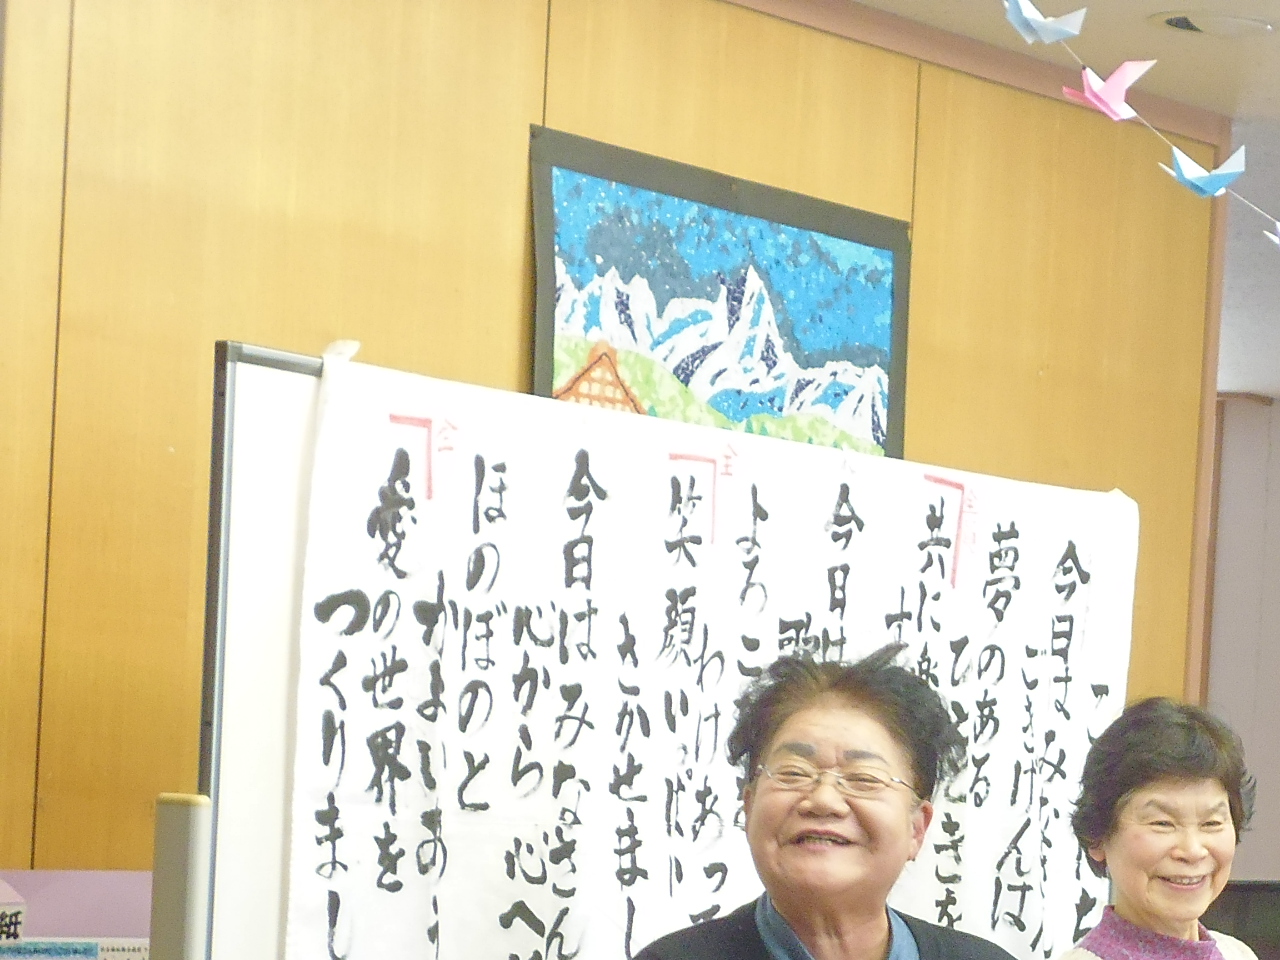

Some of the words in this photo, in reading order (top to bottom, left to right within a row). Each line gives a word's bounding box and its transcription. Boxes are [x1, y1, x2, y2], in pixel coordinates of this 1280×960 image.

[457, 452, 513, 813] ほのぼのと
[655, 475, 703, 897] 笑顔いっぱい
[968, 521, 1021, 808] 夢のある
